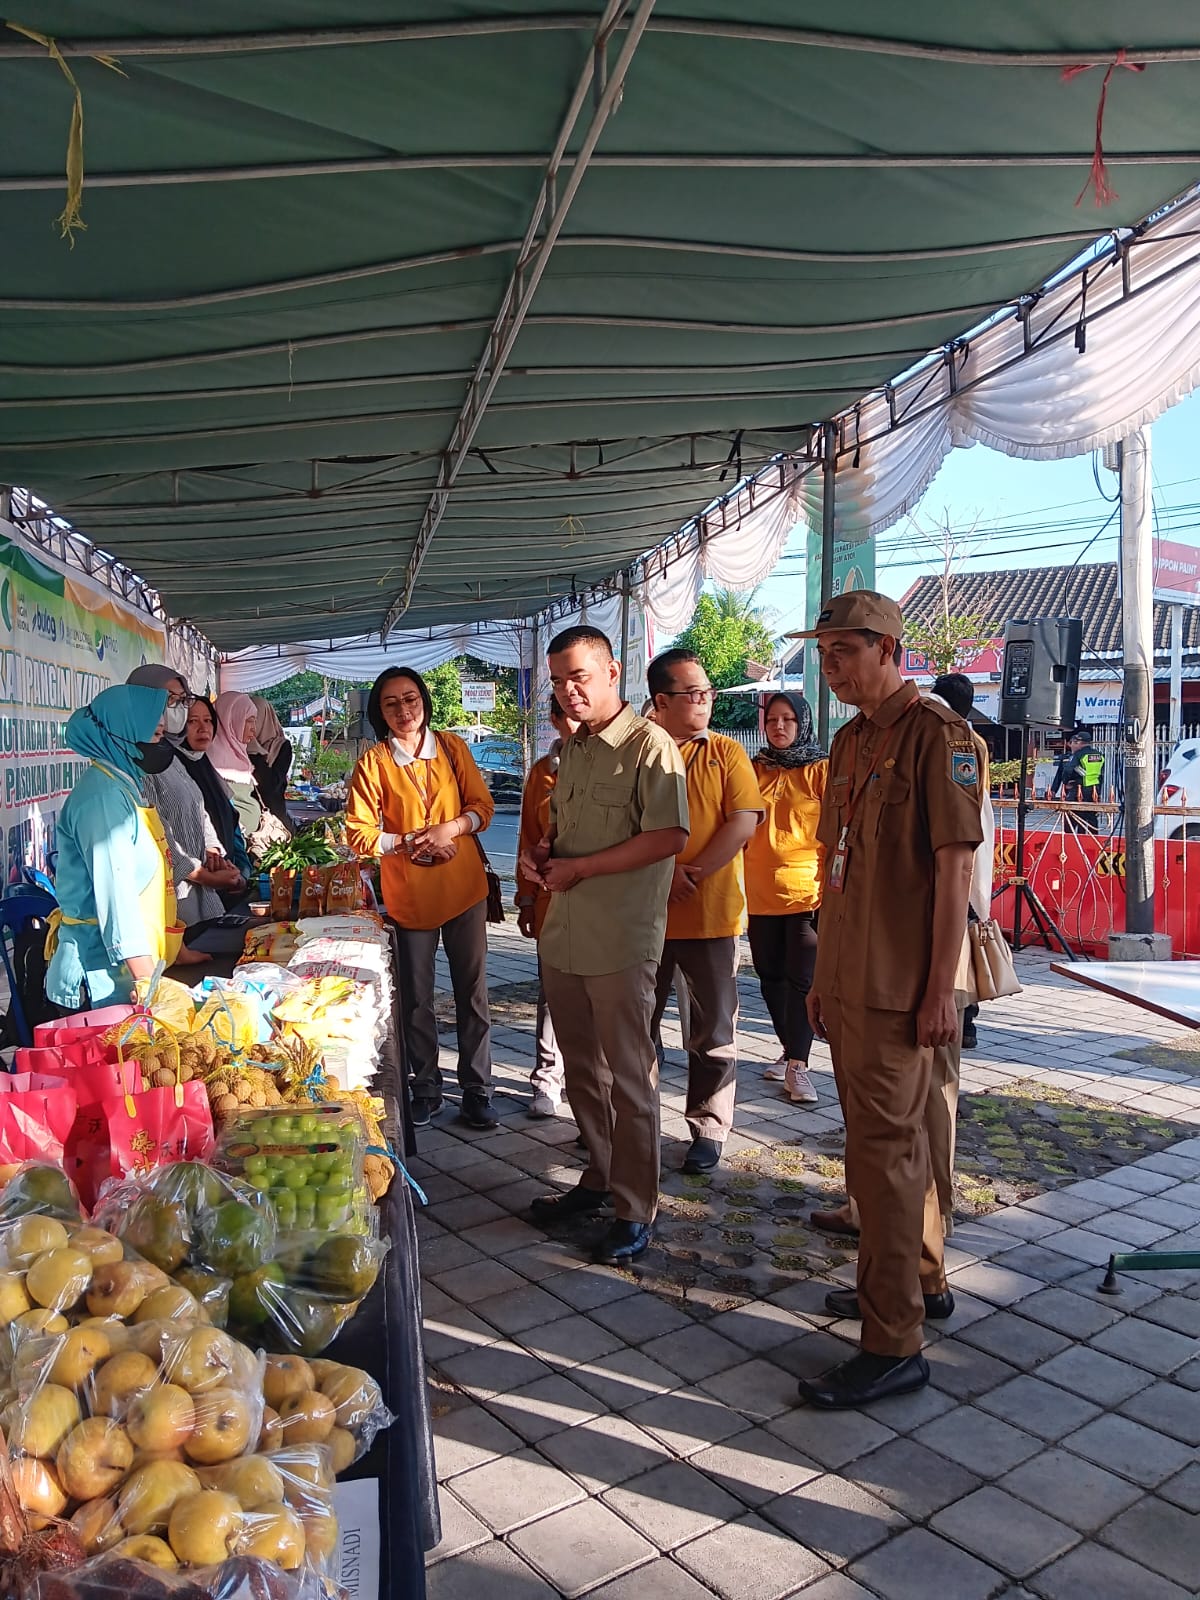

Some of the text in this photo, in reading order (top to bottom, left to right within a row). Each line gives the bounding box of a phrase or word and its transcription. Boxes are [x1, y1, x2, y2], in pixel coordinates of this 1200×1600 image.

[1154, 557, 1197, 575] NIPPON PAINT
[1085, 697, 1121, 707] Warna
[6, 765, 48, 803] PASOKAN
[341, 1527, 361, 1597] MISNADI
